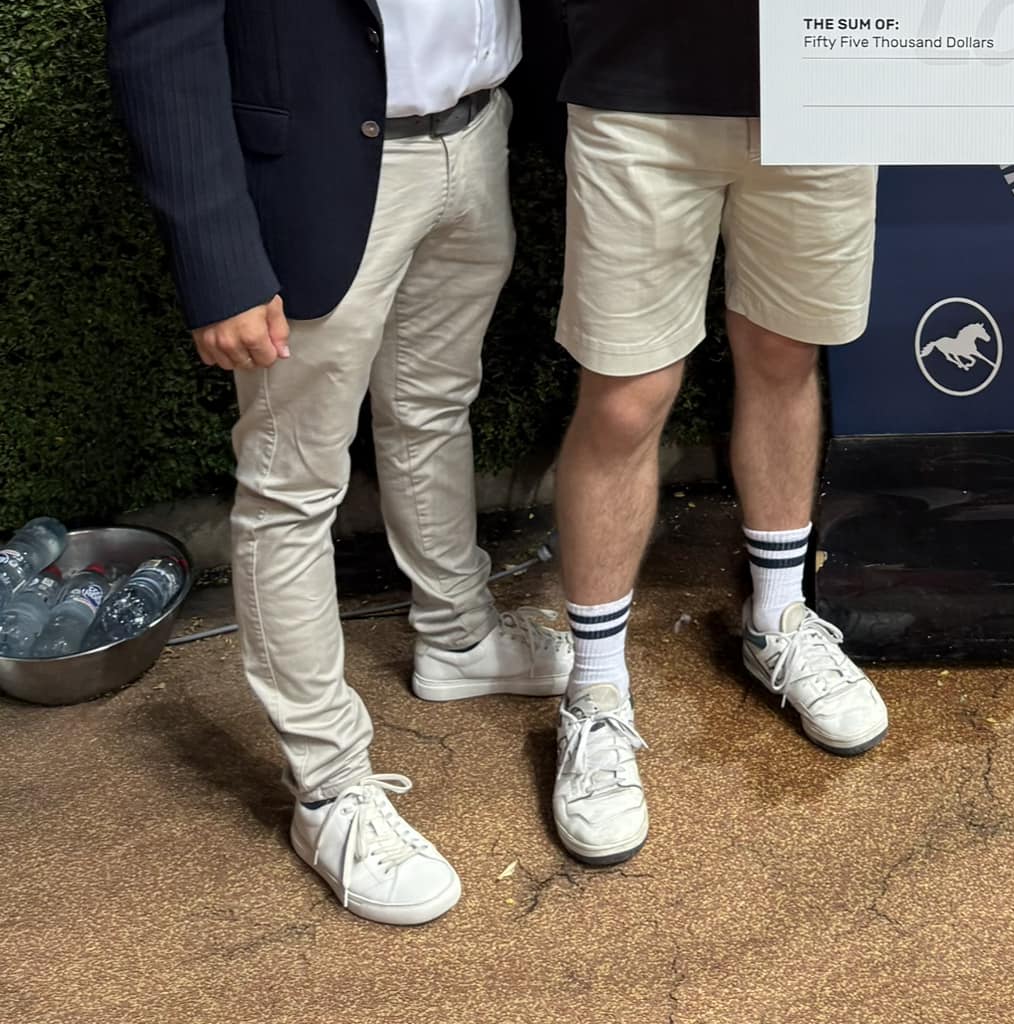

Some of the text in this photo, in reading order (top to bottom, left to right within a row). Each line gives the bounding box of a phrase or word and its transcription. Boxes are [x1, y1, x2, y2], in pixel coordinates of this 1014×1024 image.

[803, 18, 899, 31] THE SUM OF:
[804, 35, 994, 50] Fifty Five Thousand Dollars
